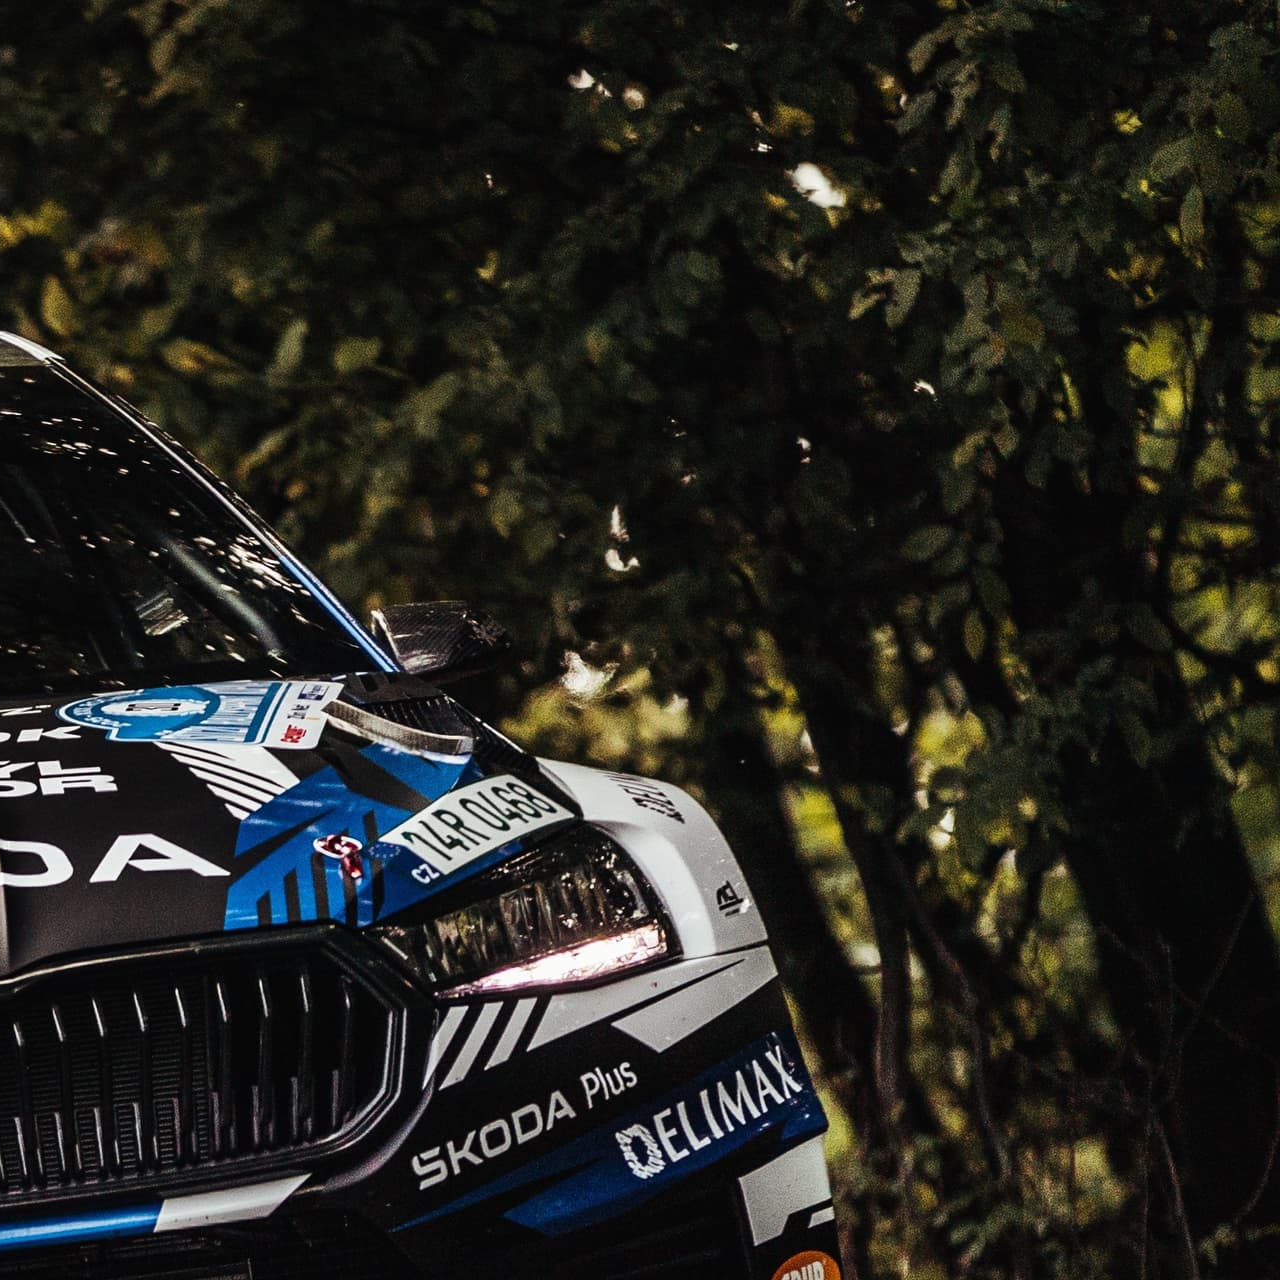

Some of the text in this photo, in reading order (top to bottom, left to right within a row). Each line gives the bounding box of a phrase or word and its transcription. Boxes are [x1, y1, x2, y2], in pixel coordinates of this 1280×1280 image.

[401, 808, 491, 861] 14R
[458, 782, 558, 831] 0468
[411, 863, 440, 884] CZ
[580, 1062, 638, 1109] Plus
[615, 1045, 803, 1180] DELIMAX
